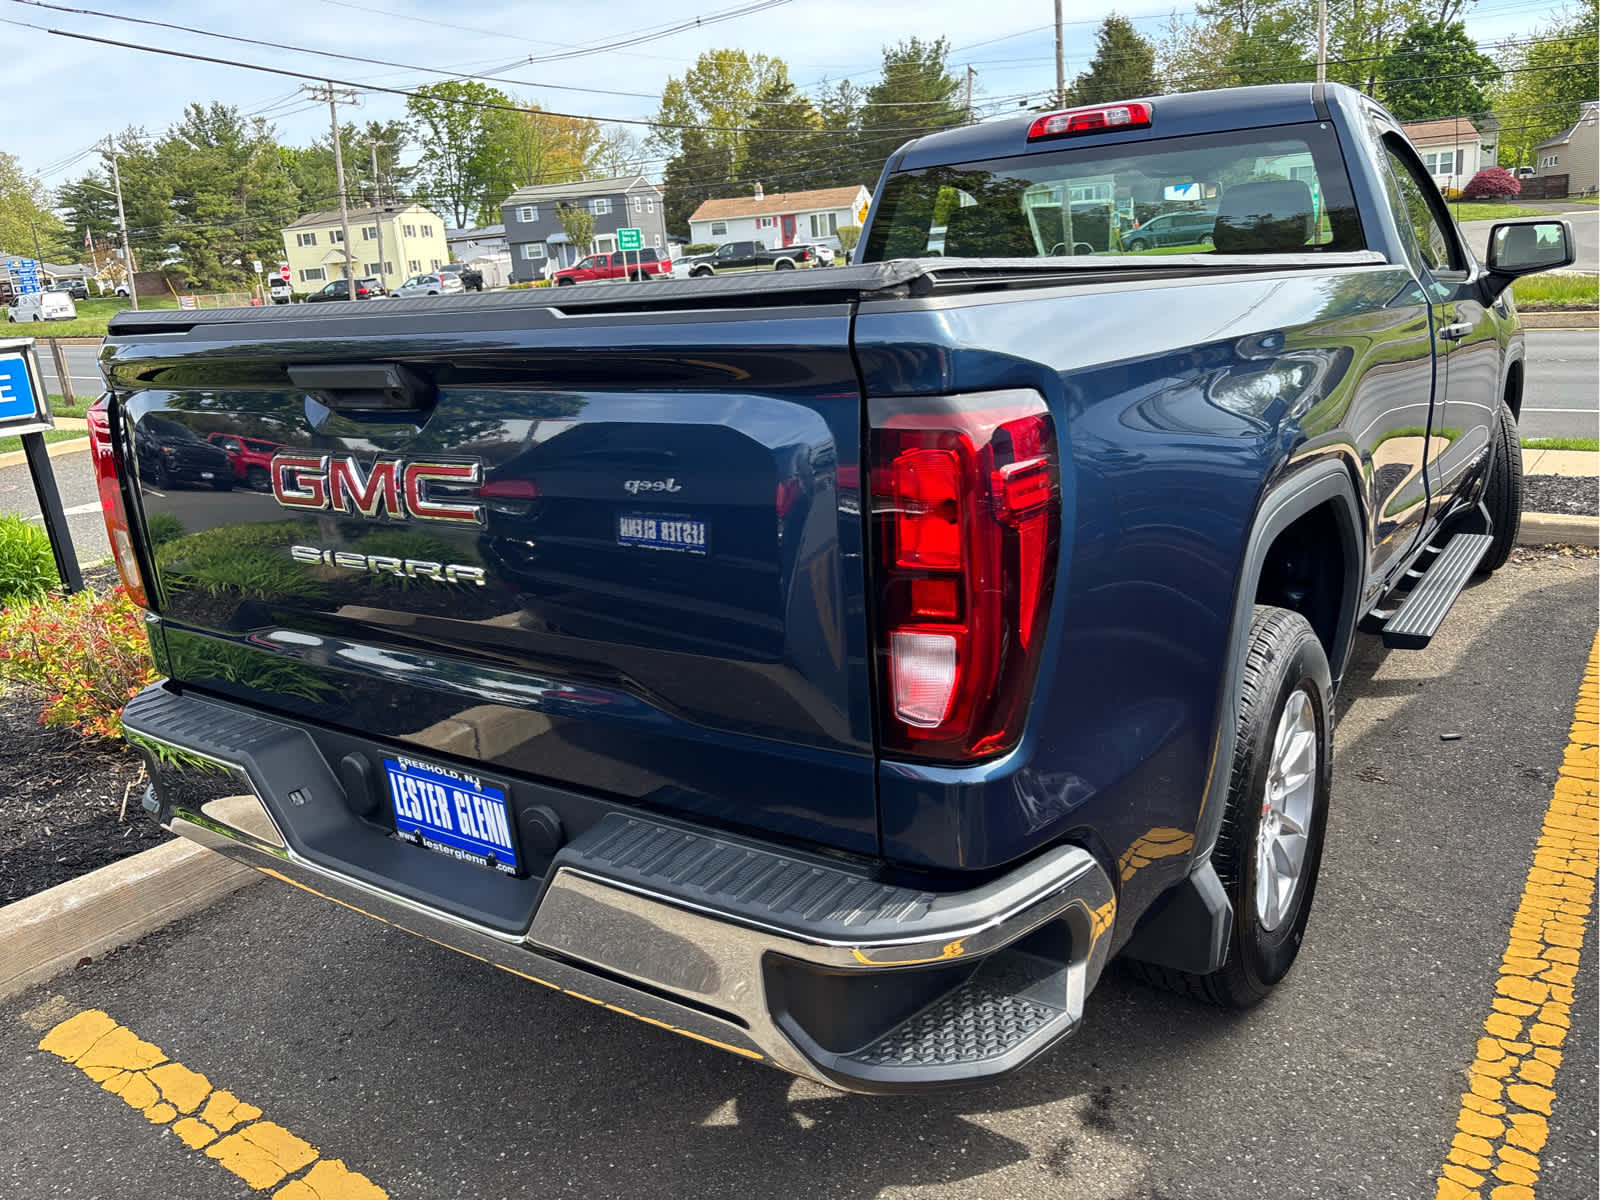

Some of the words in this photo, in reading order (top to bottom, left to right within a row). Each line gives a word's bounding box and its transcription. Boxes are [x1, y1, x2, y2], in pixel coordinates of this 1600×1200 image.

[271, 455, 487, 526] GMC
[291, 546, 486, 586] SIERRA
[389, 773, 453, 830] LESTER
[453, 790, 512, 849] GLENN
